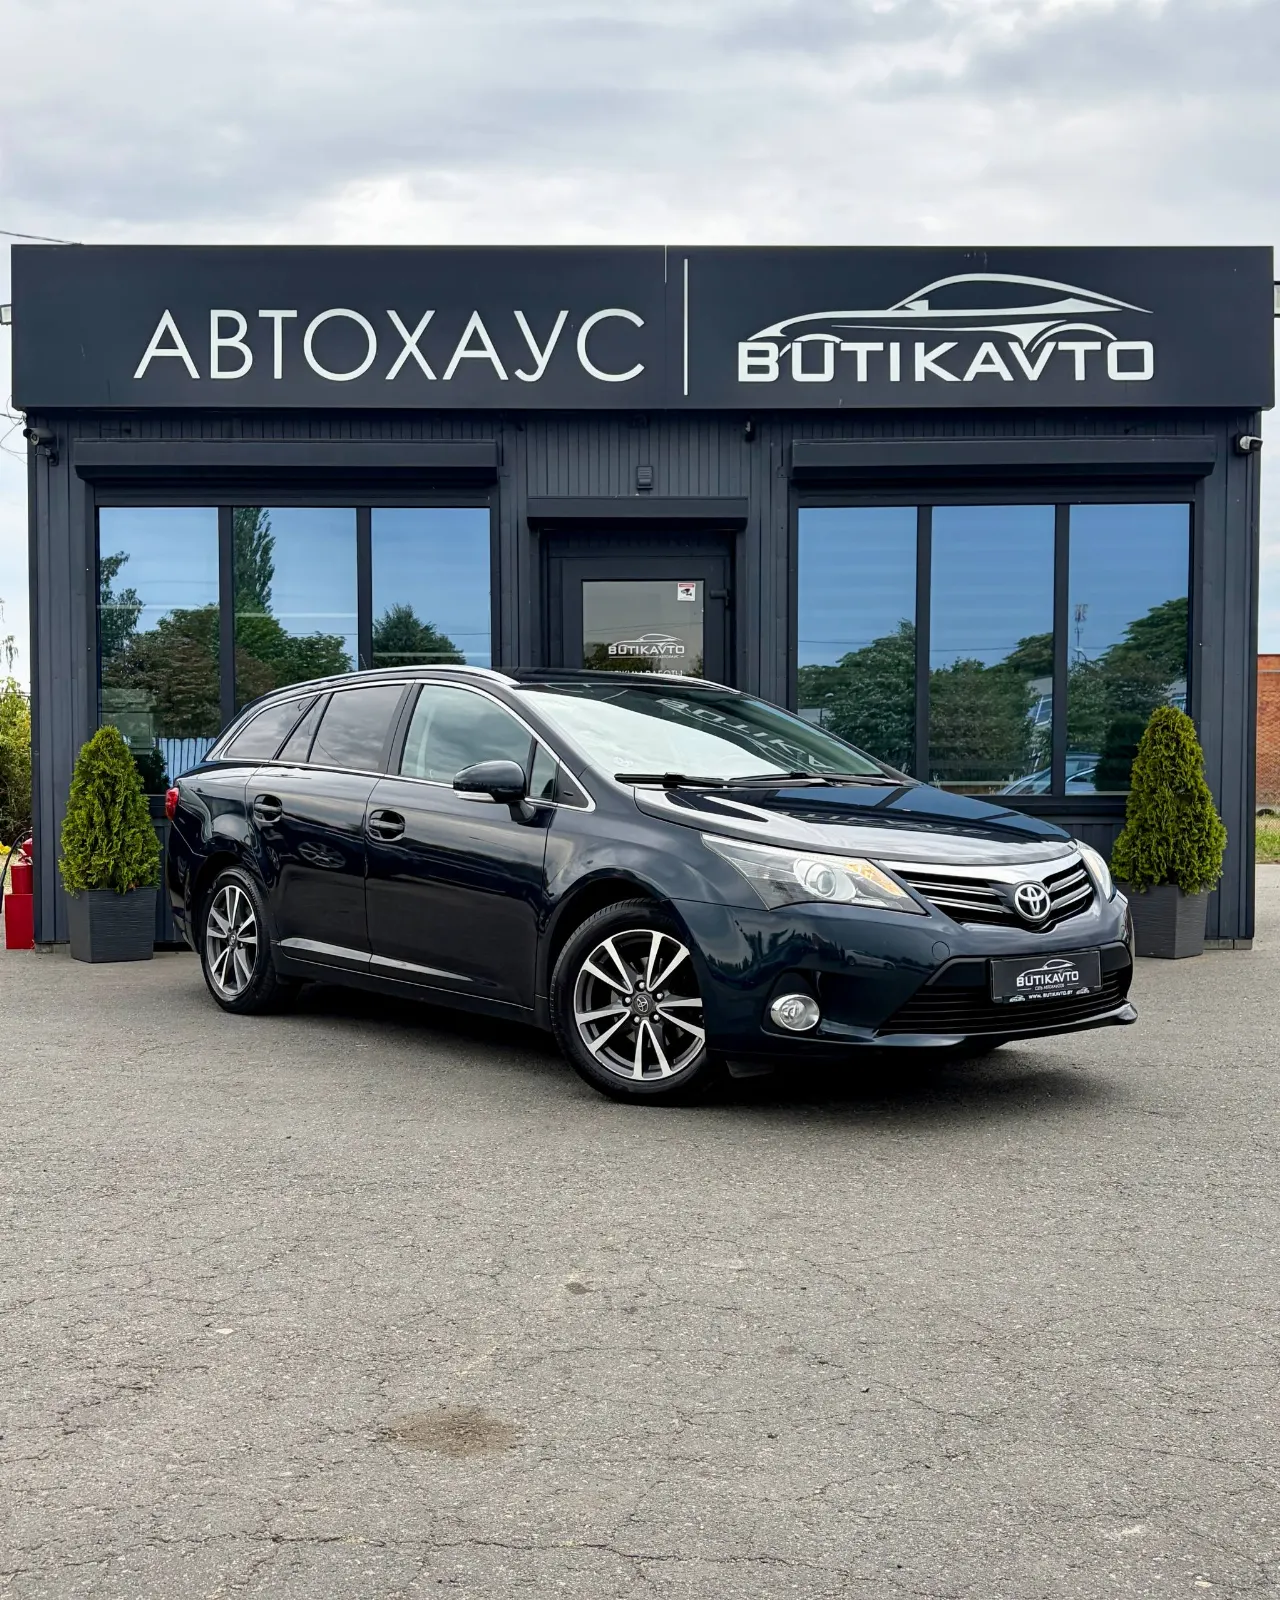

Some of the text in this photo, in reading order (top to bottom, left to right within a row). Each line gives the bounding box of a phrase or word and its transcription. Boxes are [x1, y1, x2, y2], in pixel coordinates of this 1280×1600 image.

[133, 308, 647, 383] АВТОХАУС
[737, 339, 1155, 383] BUTIKAVTO
[608, 645, 685, 655] BUTIKAVTO
[1016, 970, 1079, 987] BUTIKAVTO
